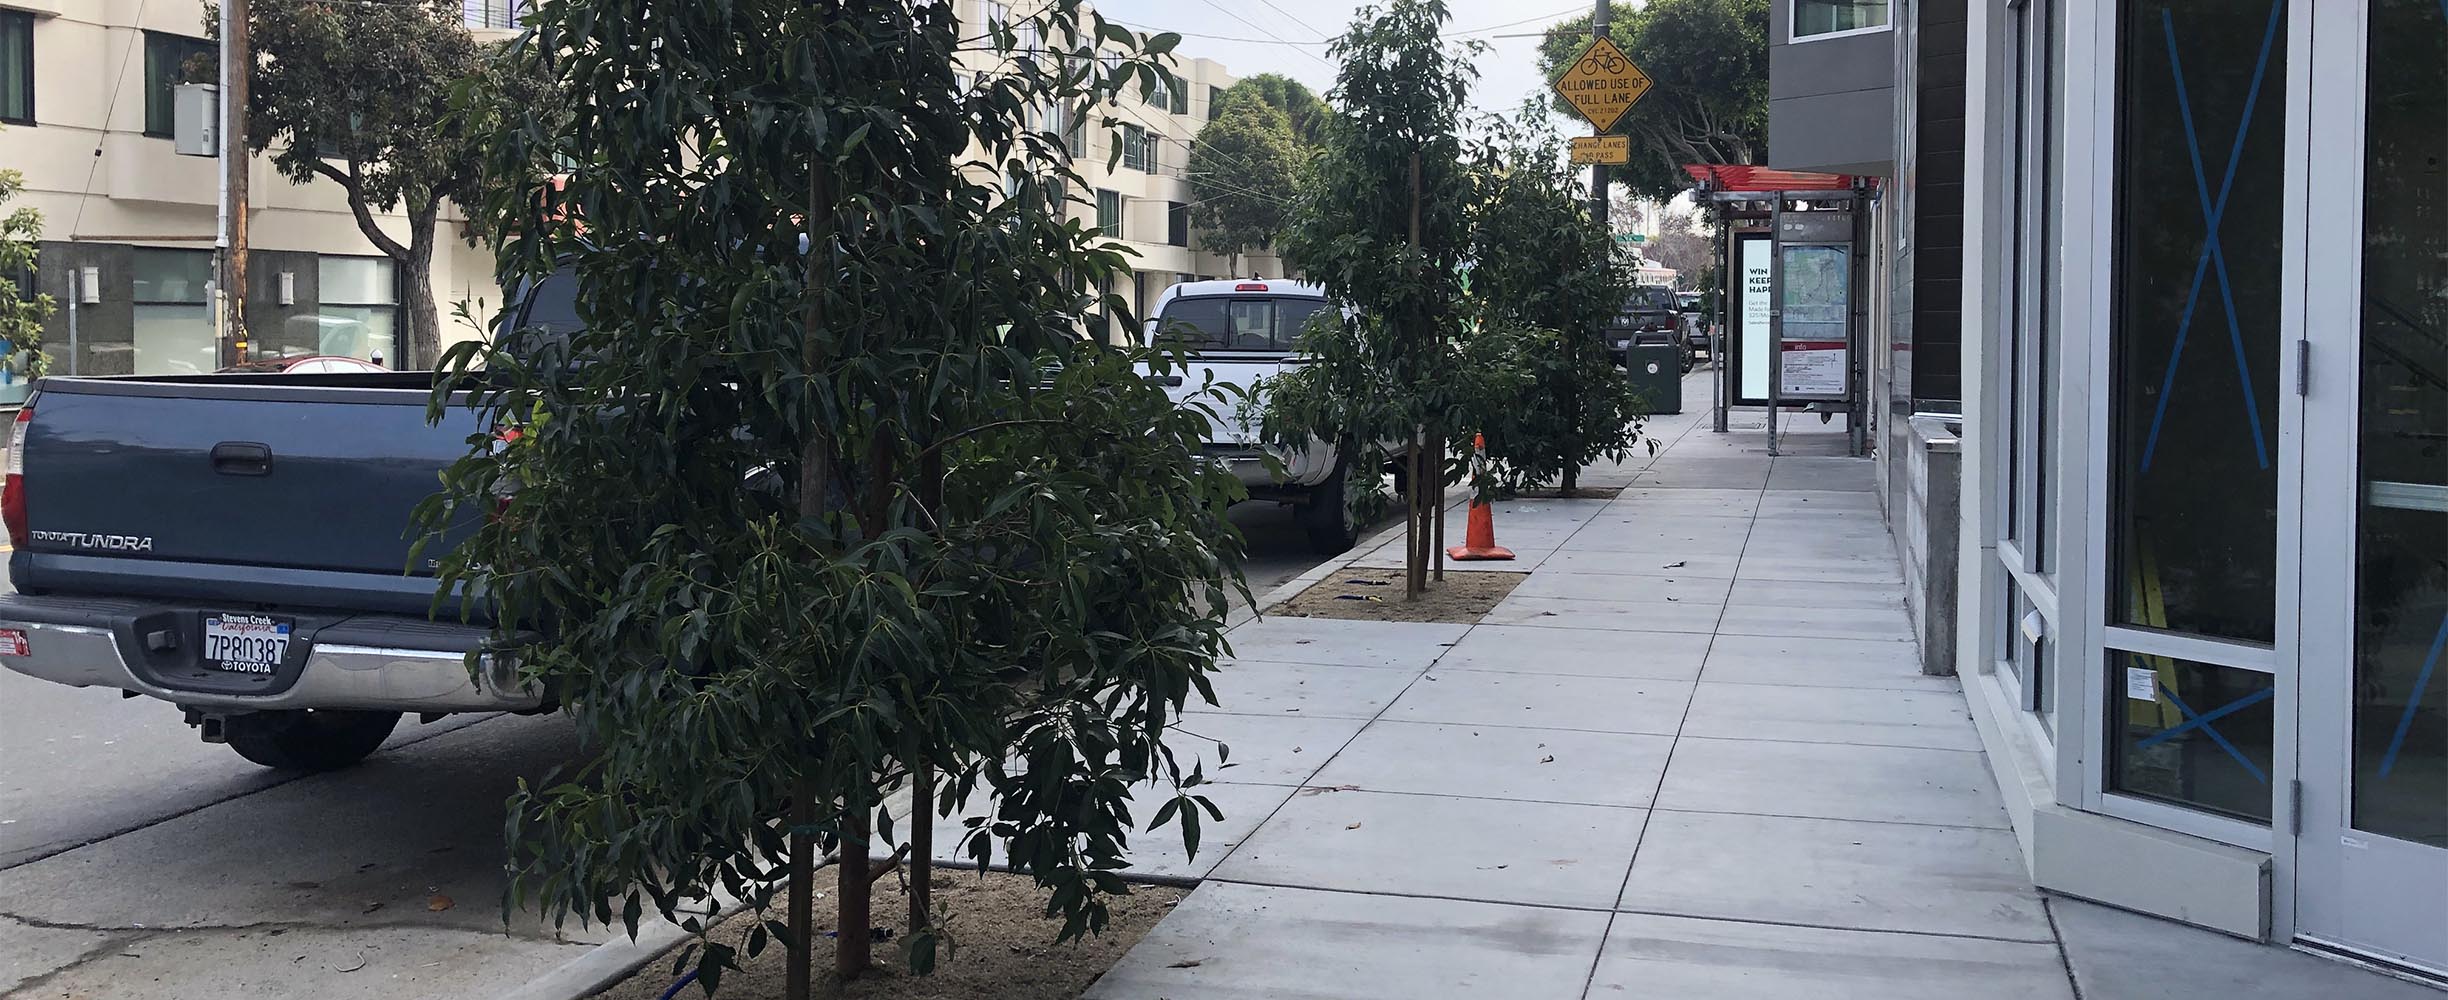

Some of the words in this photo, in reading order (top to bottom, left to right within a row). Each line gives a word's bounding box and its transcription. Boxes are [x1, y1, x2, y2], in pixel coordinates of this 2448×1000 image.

[1560, 79, 1607, 91] ALLOWED
[1610, 78, 1629, 90] USE
[1631, 77, 1645, 89] OF
[1574, 94, 1600, 105] FULL
[1604, 93, 1631, 104] LANE
[1603, 141, 1626, 149] LANES
[1595, 151, 1614, 159] PASS
[1794, 343, 1807, 351] info
[32, 530, 68, 542] TOYOTA
[66, 533, 153, 551] TUNDRA
[221, 613, 249, 624] Stevens
[250, 615, 272, 625] Creek
[221, 622, 276, 635] California
[208, 634, 287, 663] 7P80387
[233, 662, 271, 673] TOYOTA
